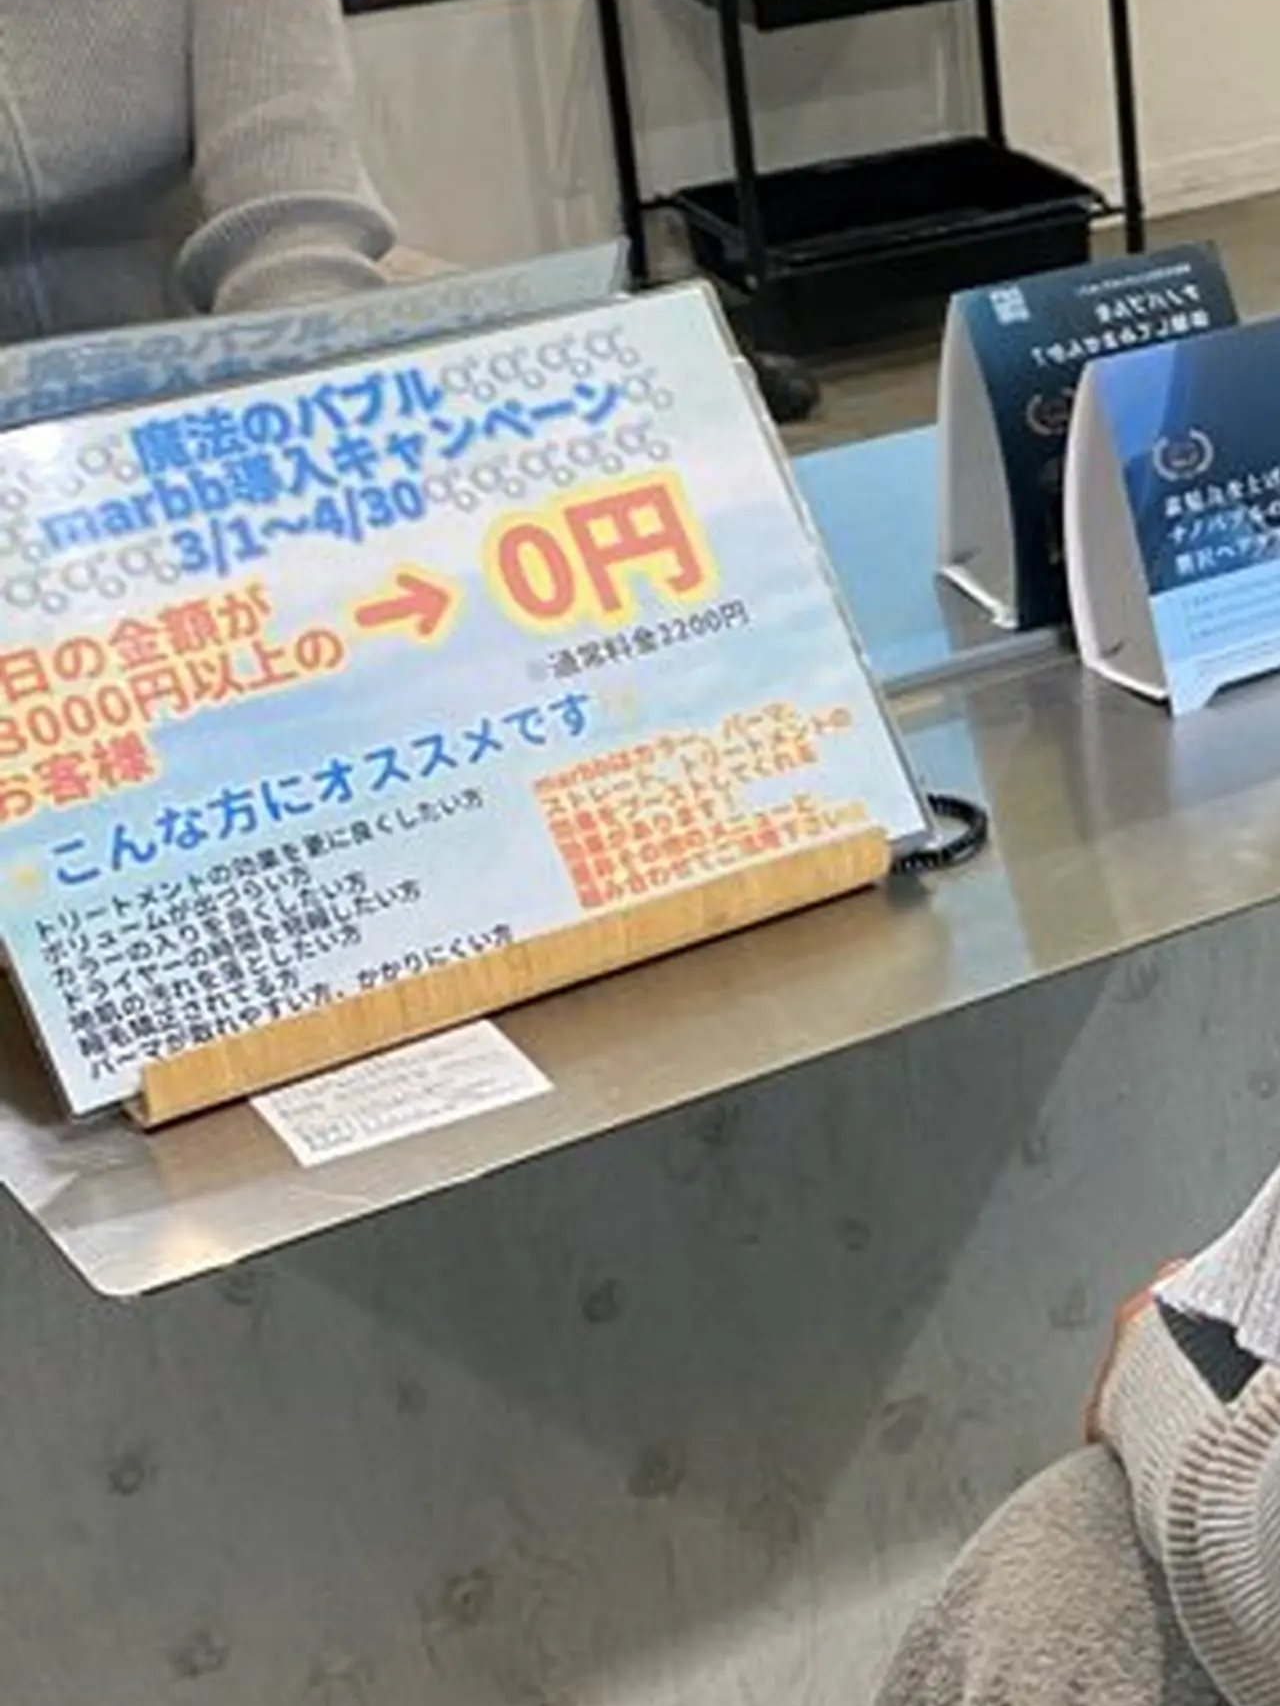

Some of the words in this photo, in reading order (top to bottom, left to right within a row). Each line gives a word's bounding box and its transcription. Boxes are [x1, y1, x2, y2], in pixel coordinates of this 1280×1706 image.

[39, 381, 622, 549] marbb導入キャンペーン
[131, 367, 444, 475] 魔法のバブル
[497, 482, 703, 620] 0円
[52, 693, 590, 885] こんな方にオススメです
